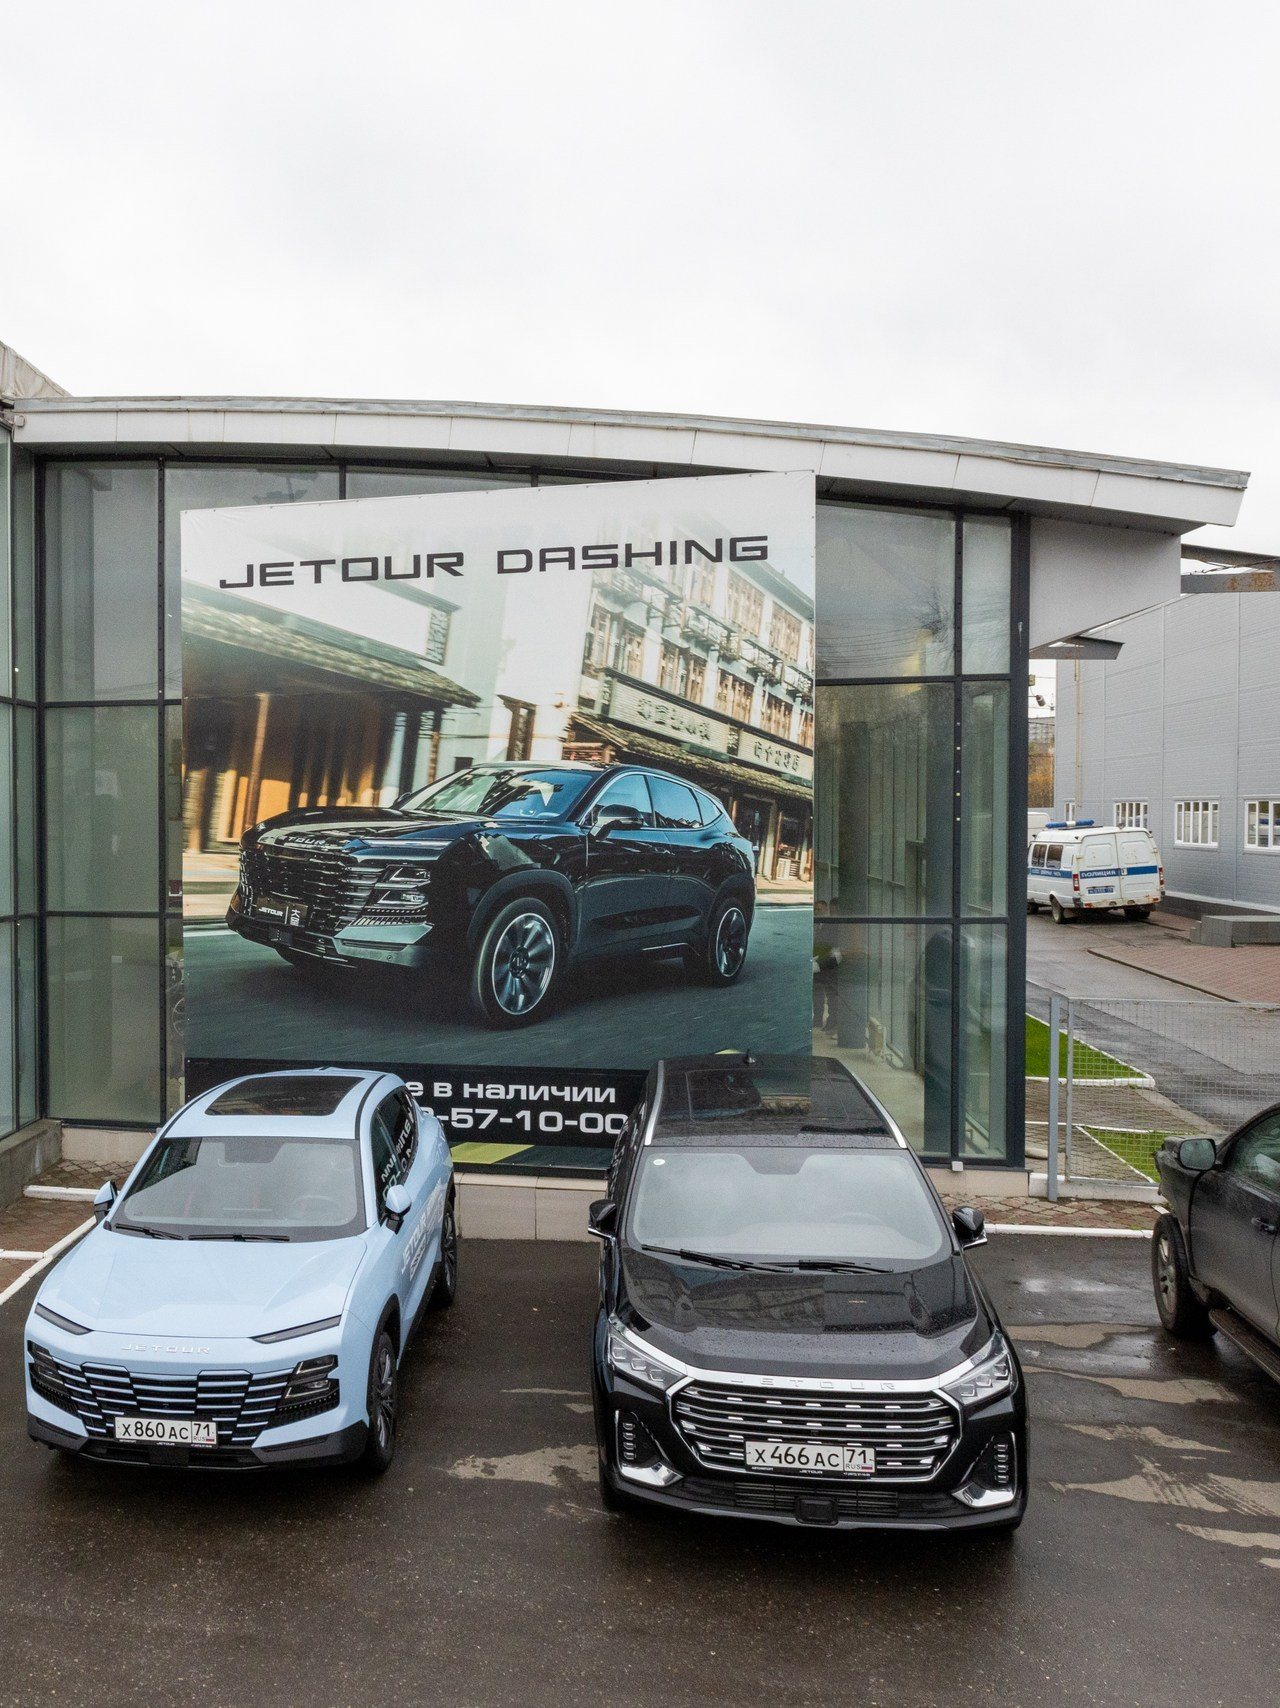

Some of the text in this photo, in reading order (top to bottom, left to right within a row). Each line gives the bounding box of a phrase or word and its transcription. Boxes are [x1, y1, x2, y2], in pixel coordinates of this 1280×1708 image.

[219, 535, 768, 589] JETOUR DASHING
[1081, 870, 1116, 878] ПОЛИЦИЯ
[258, 906, 283, 916] JETOUR
[433, 1082, 453, 1098] в
[463, 1082, 616, 1103] наличии
[120, 1343, 210, 1354] JETOUR
[731, 1375, 896, 1391] JETOUR
[193, 1423, 211, 1437] 71
[846, 1448, 867, 1464] 71
